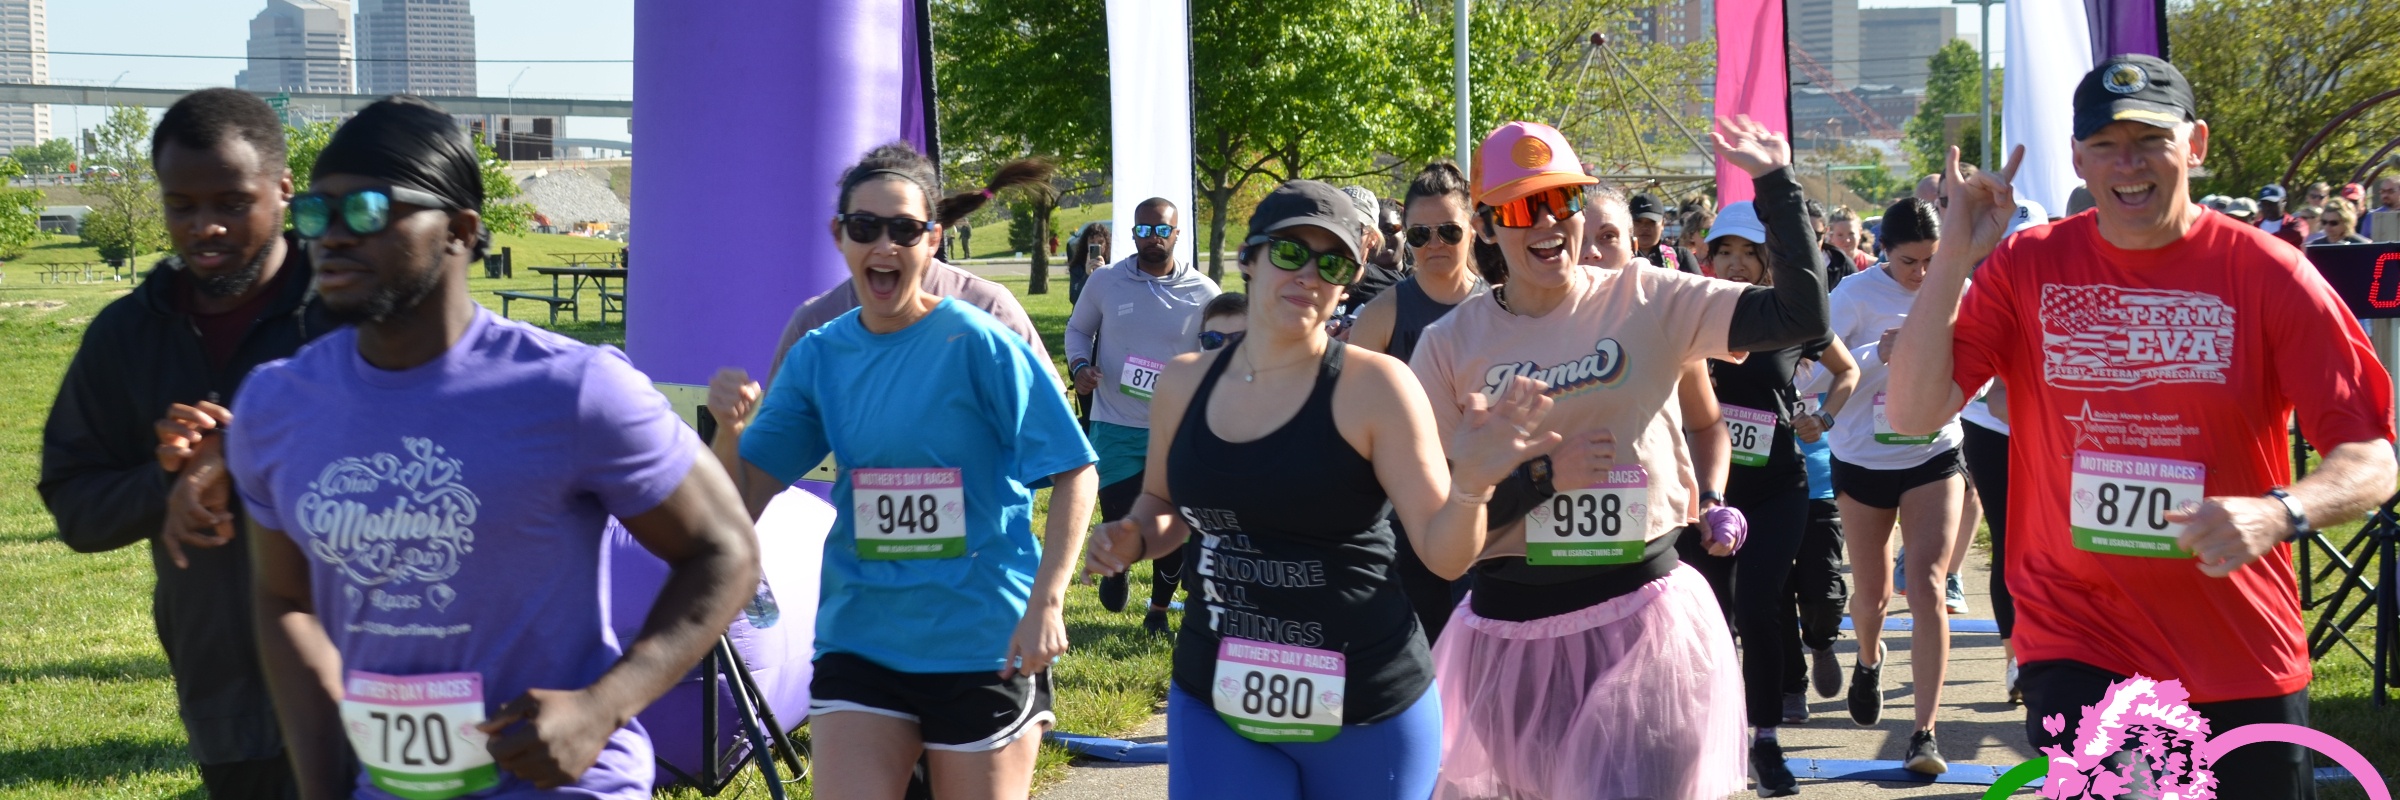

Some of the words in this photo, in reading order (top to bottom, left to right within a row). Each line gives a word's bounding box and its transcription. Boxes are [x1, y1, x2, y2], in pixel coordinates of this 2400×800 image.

[2019, 206, 2029, 219] B
[2055, 367, 2087, 376] EVERY
[2093, 368, 2140, 379] VETERAN
[2146, 370, 2217, 380] APPRECIATED
[1720, 407, 1739, 418] HER'S
[1739, 410, 1752, 420] DAY
[1752, 412, 1772, 424] RACES
[2084, 421, 2127, 434] Veterans
[2128, 422, 2200, 437] Organizations
[2152, 412, 2179, 422] Support
[1725, 421, 1757, 450] 36
[2105, 435, 2120, 445] on
[2122, 433, 2148, 448] Long
[2149, 434, 2181, 447] Island
[859, 472, 903, 486] MOTHER'S
[903, 473, 922, 486] DAY
[924, 472, 955, 486] RACES
[1608, 470, 1640, 484] RACES
[2080, 456, 2133, 475] MOTHER'S
[2135, 464, 2159, 477] DAY
[2160, 466, 2196, 481] RACES
[877, 494, 939, 534] 948
[1180, 506, 1242, 532] SHE
[1553, 493, 1622, 538] 938
[2096, 482, 2171, 531] 870
[300, 494, 458, 551] Mother's
[1197, 547, 1327, 588] ENDURE
[1203, 578, 1260, 610] ALL
[1206, 604, 1325, 648] THINGS
[1226, 643, 1280, 663] MOTHER'S
[1280, 650, 1304, 666] DAY
[1303, 653, 1339, 671] RACES
[400, 682, 425, 700] DAY
[427, 679, 472, 699] RACES
[1242, 670, 1314, 719] 880
[369, 710, 453, 766] 720
